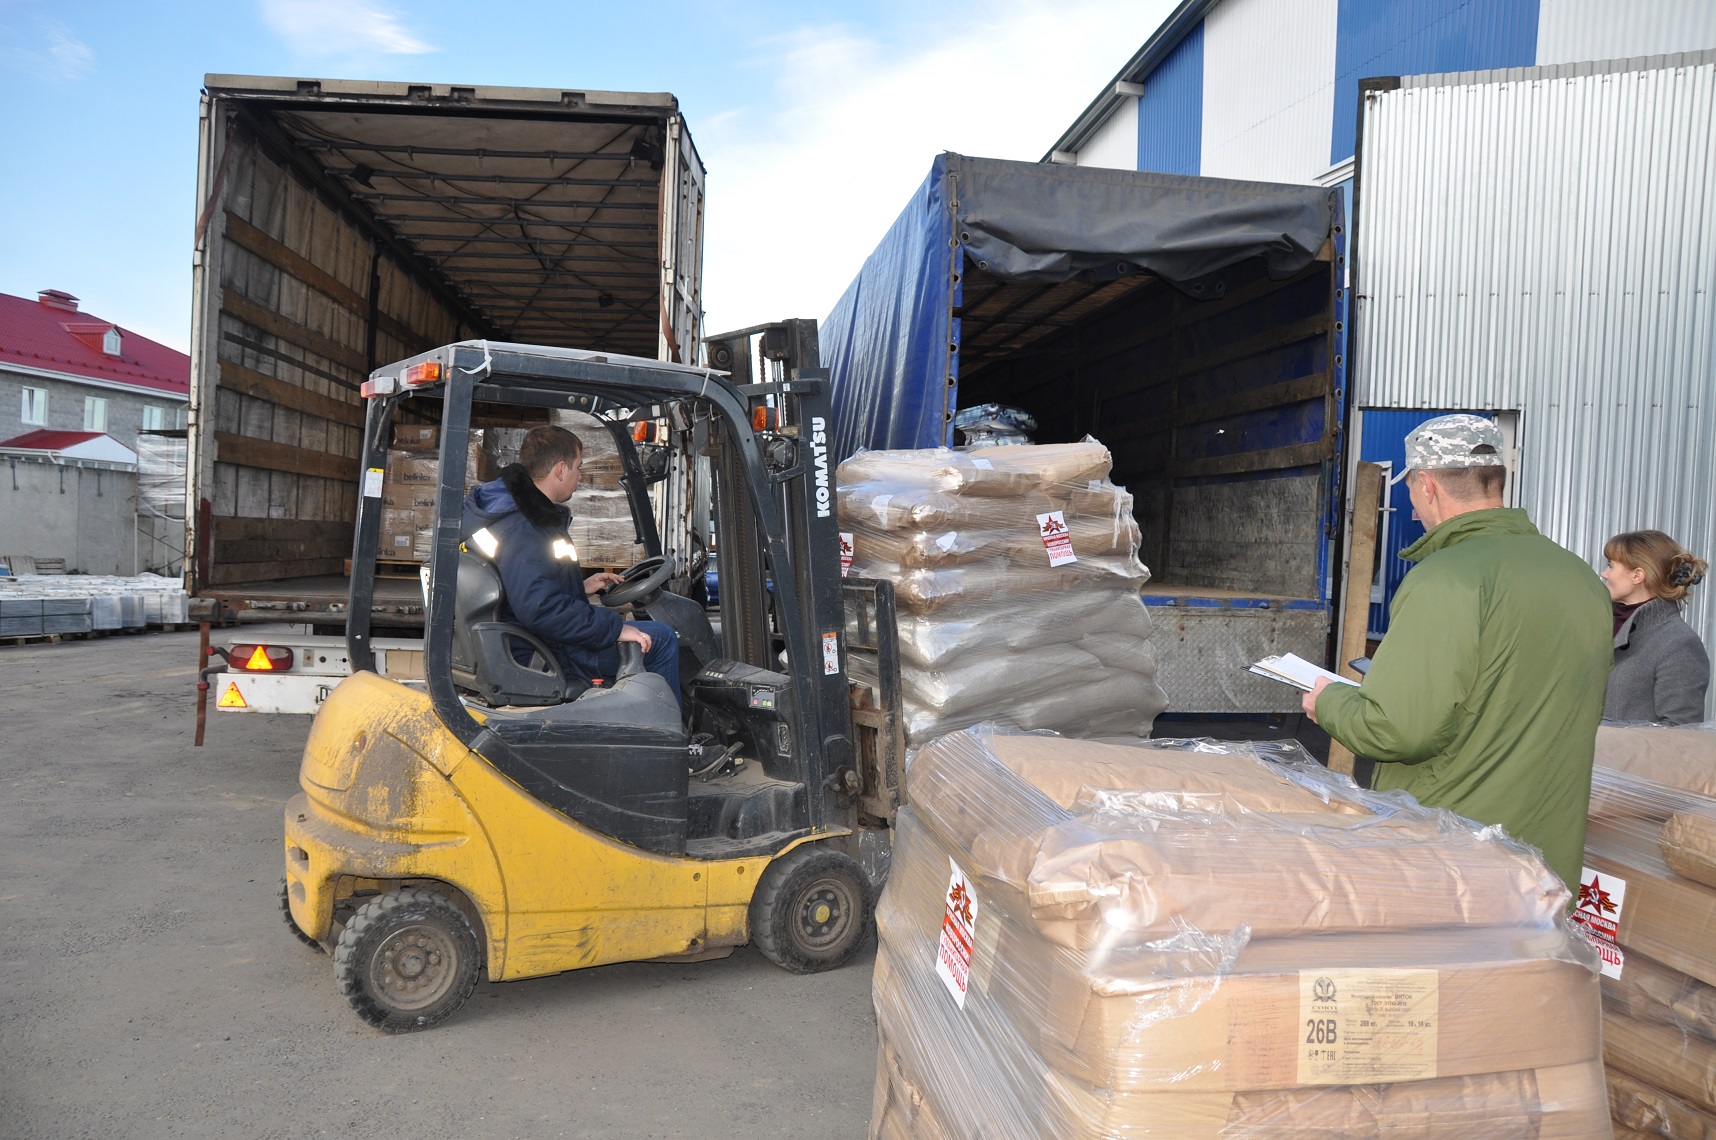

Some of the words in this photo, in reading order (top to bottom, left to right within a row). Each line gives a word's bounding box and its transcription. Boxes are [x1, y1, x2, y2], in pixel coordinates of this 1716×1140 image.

[809, 416, 830, 517] KOMATSU
[403, 472, 431, 481] belinka
[414, 498, 434, 507] belink
[1591, 915, 1617, 932] МОСКВА
[939, 943, 966, 993] ПОМОЩЬ
